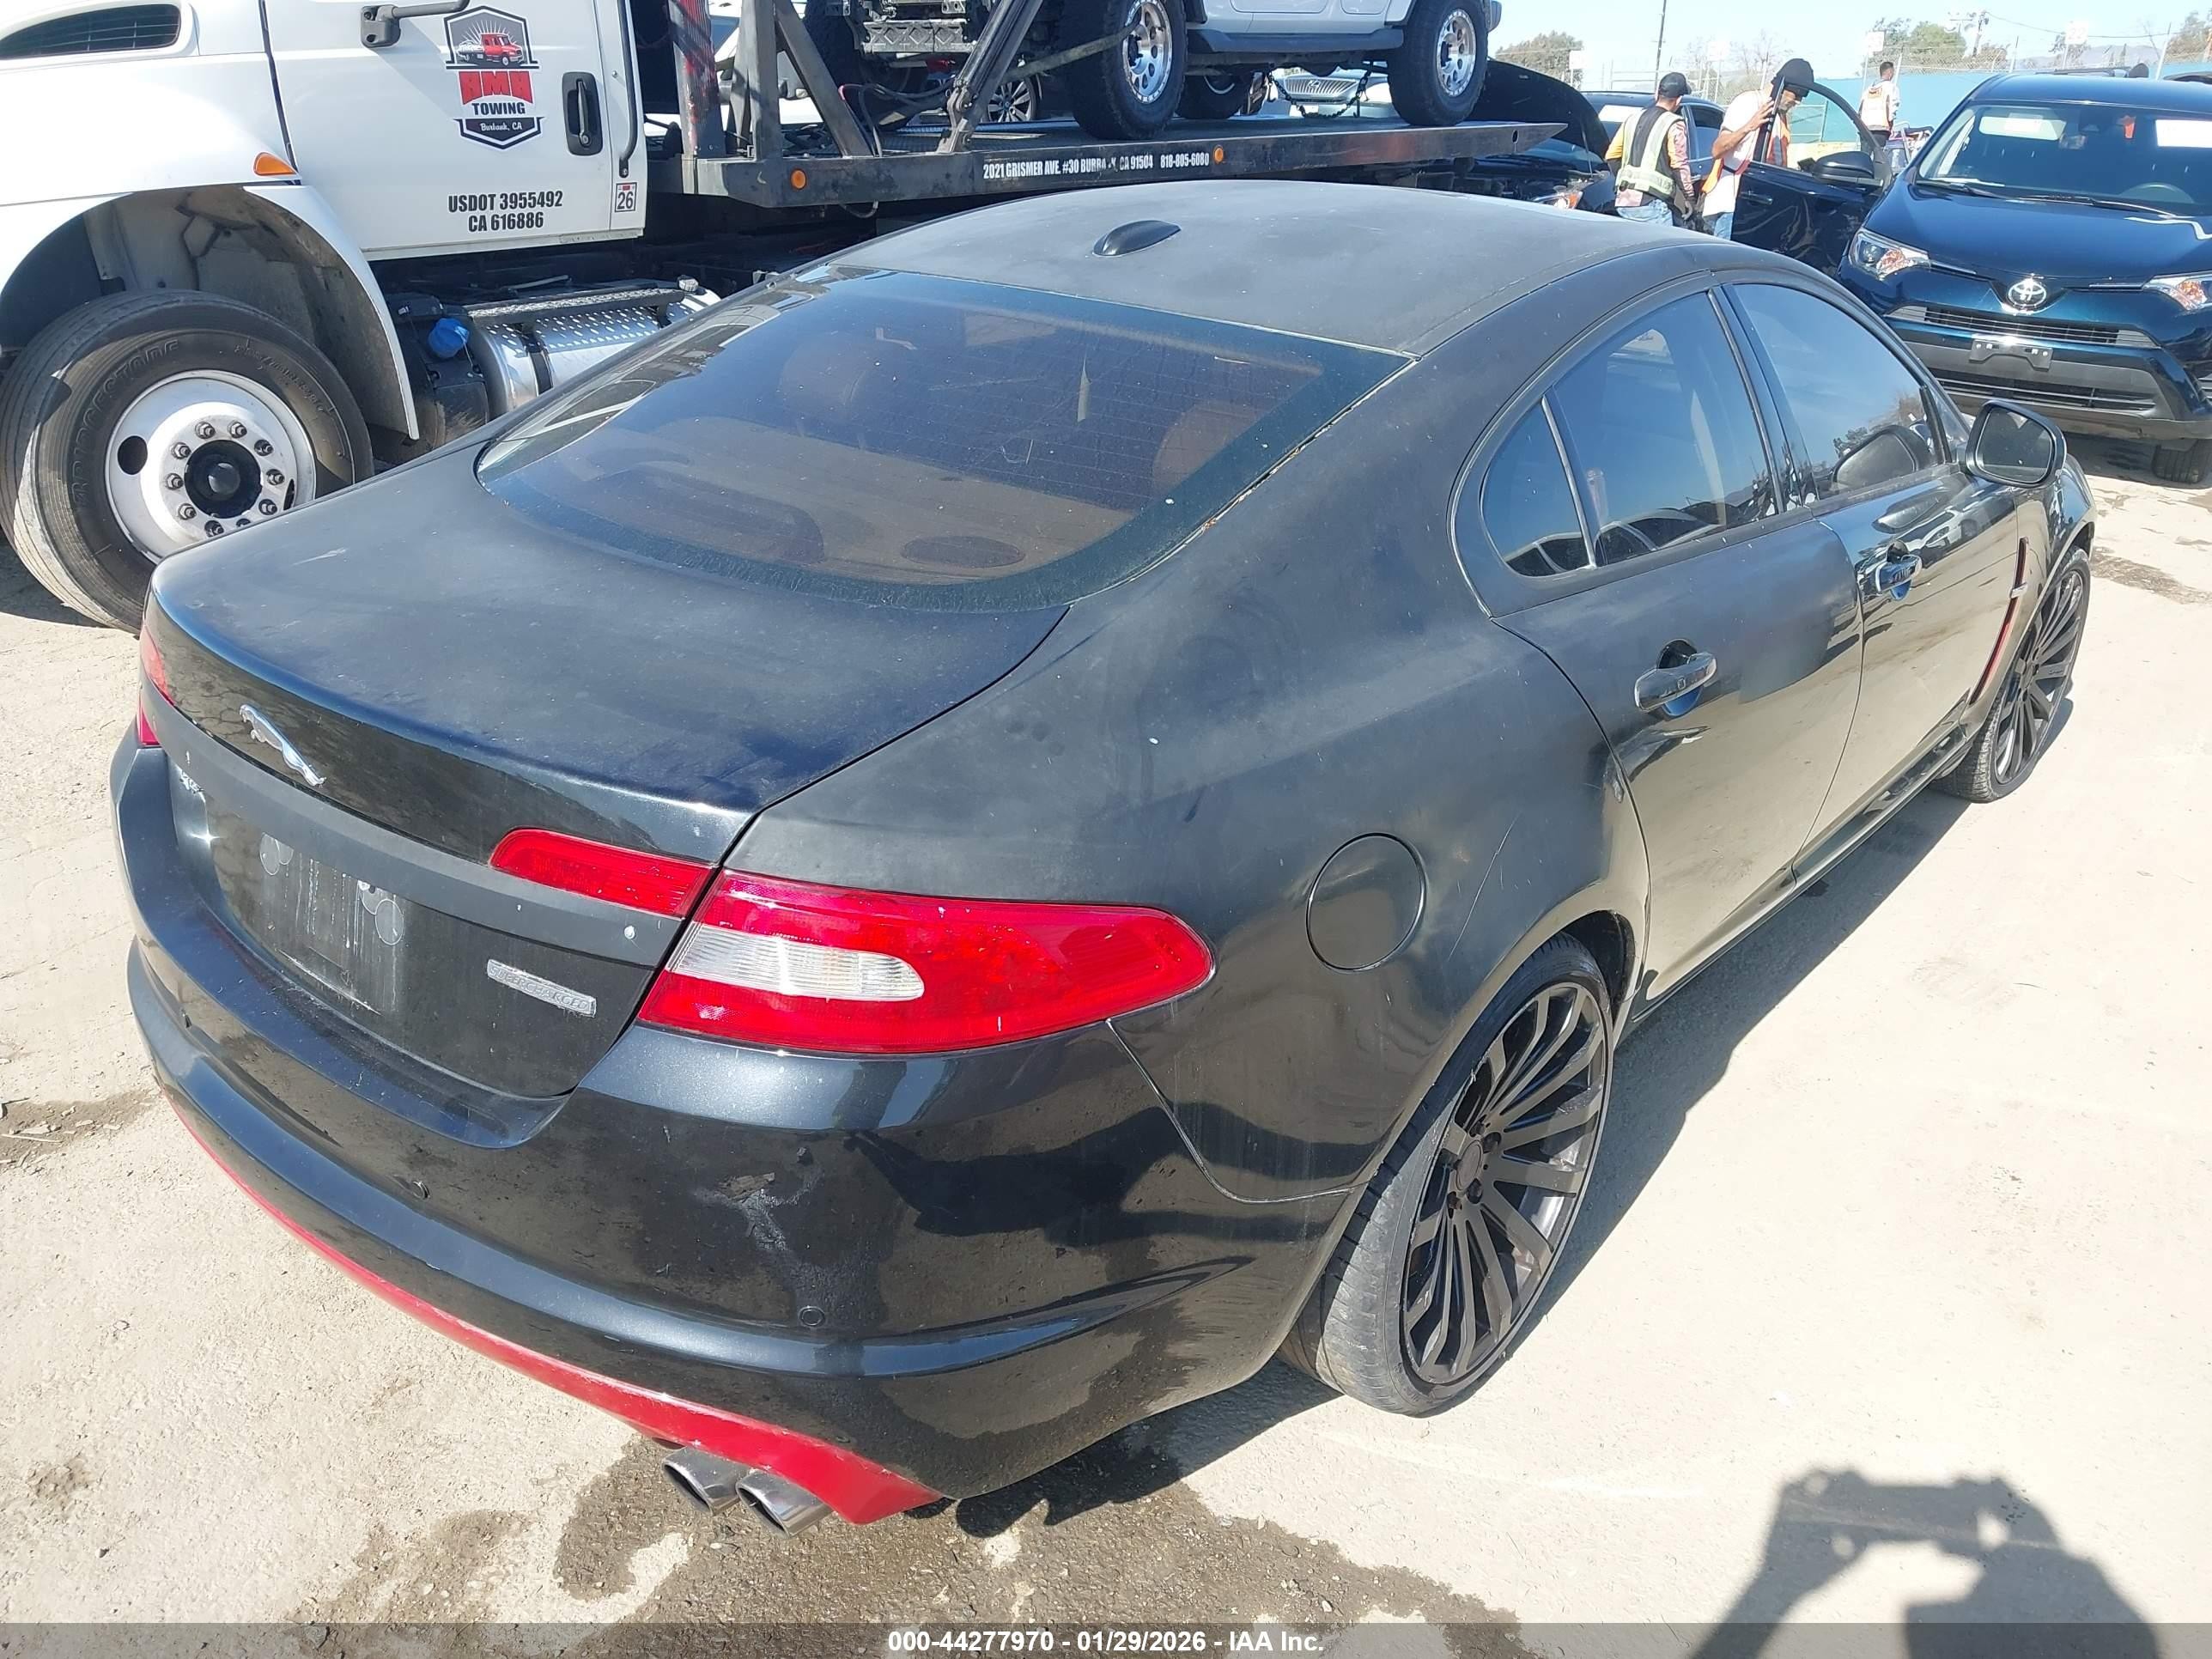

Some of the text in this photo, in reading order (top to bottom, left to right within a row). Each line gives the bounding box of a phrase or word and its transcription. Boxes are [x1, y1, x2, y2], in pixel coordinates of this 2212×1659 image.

[471, 101, 526, 116] TOWING
[480, 121, 523, 131] Burbank, CA
[983, 163, 1005, 179] 2021
[1006, 161, 1043, 178] GRISMER
[1044, 160, 1061, 175] AVE.
[1062, 159, 1079, 174] #30
[1120, 155, 1130, 171] CA
[1130, 155, 1153, 170] 91504
[1160, 152, 1210, 168] 818-805-6080
[448, 190, 563, 213] USDOT 3955492
[617, 191, 634, 210] 26
[468, 212, 544, 233] CA 616886
[489, 966, 590, 1012] SUPERCHARGED
